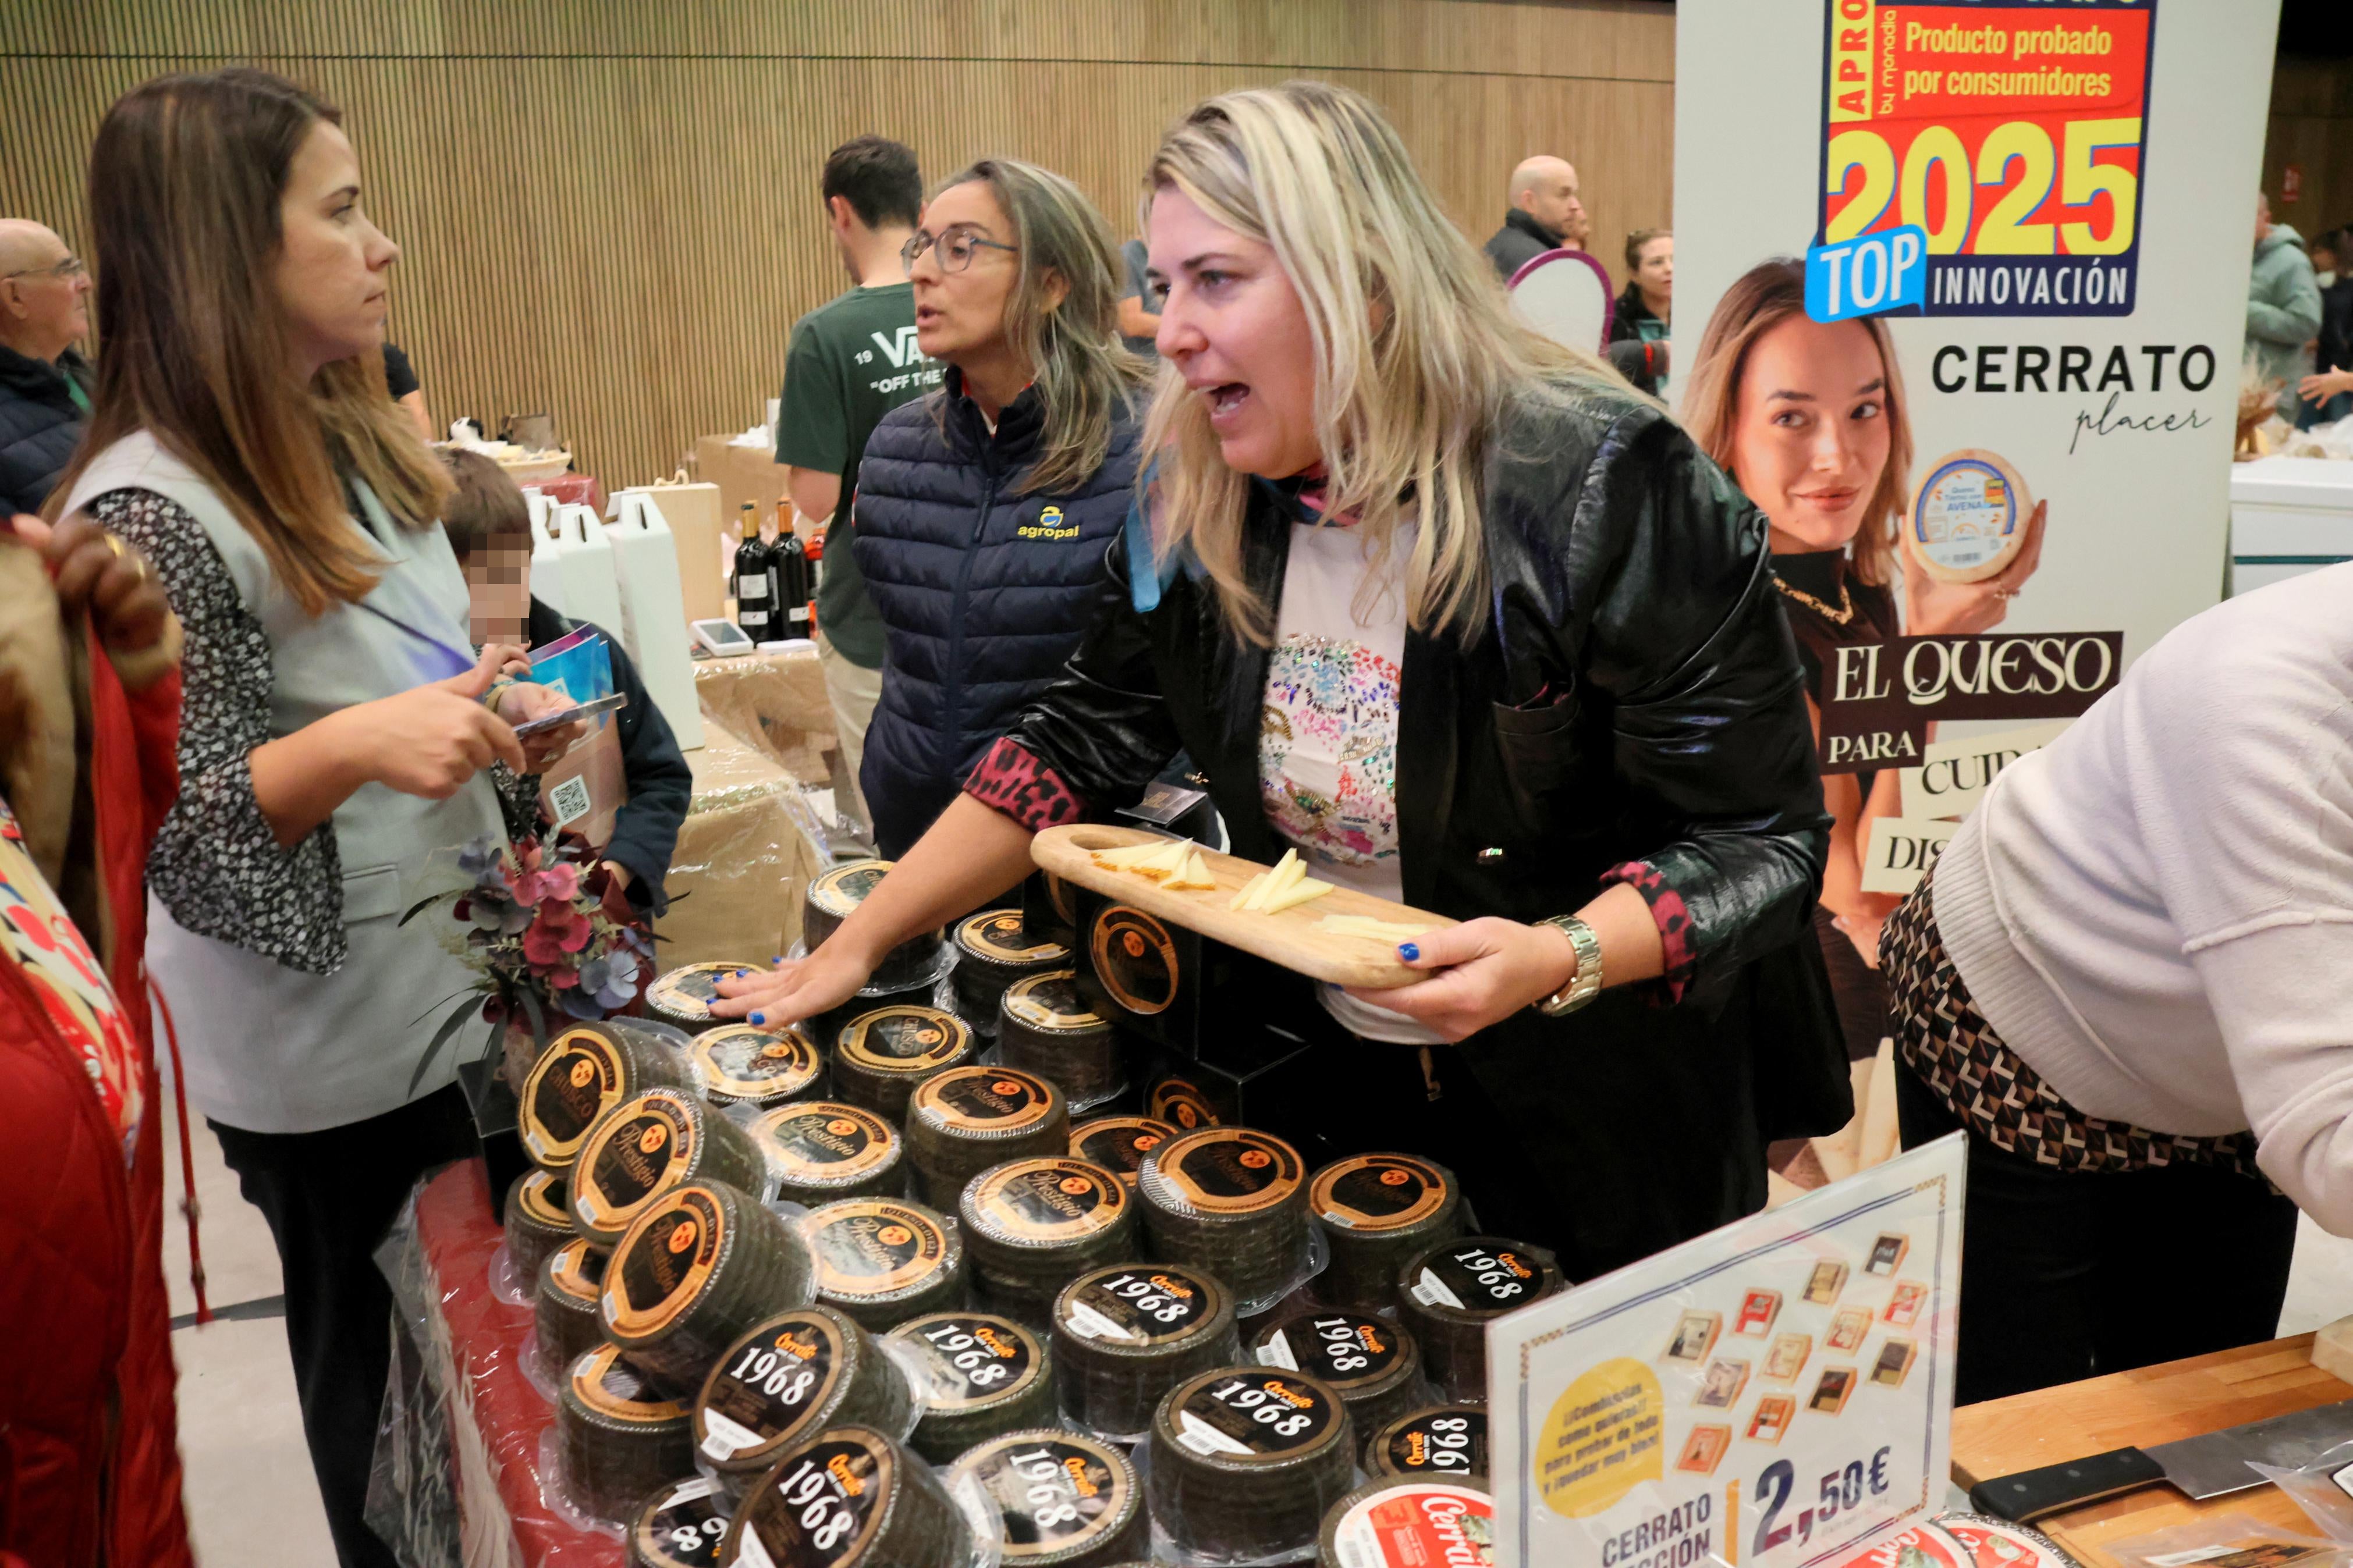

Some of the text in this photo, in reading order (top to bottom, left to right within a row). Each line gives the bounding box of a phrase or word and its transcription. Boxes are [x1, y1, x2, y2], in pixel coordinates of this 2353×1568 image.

[1905, 22, 2111, 60] Producto probado
[1878, 93, 1896, 115] by
[1904, 66, 2111, 100] por consumidores
[1825, 118, 2142, 255] 2025
[1820, 233, 1920, 316] TOP
[1933, 257, 2128, 305] INNOVACIÓN
[854, 350, 873, 365] 19
[911, 369, 942, 387] THE
[1932, 344, 2216, 394] CERRATO
[2070, 392, 2212, 454] placer
[1947, 501, 1982, 511] AVENA
[1017, 525, 1080, 540] agropal
[1833, 637, 2111, 705] EL QUESO
[1827, 730, 1918, 765] PARA
[612, 1122, 656, 1187] Prestigio
[790, 1116, 856, 1155] Prestigio
[1023, 1171, 1081, 1217] Prestigio
[843, 1217, 897, 1270] Prestigio
[1102, 1274, 1190, 1322] 1968
[1454, 1249, 1522, 1299] 1968
[924, 1324, 1007, 1385] 1968
[1314, 1317, 1368, 1371] 1968
[730, 1347, 815, 1405] 1968
[1211, 1381, 1312, 1437] 1968
[778, 1460, 853, 1550] 1968
[1009, 1448, 1077, 1527] 1968
[1752, 1445, 1892, 1558] 2,50€
[670, 1517, 729, 1552] 68
[1602, 1493, 1710, 1568] CERRATO
